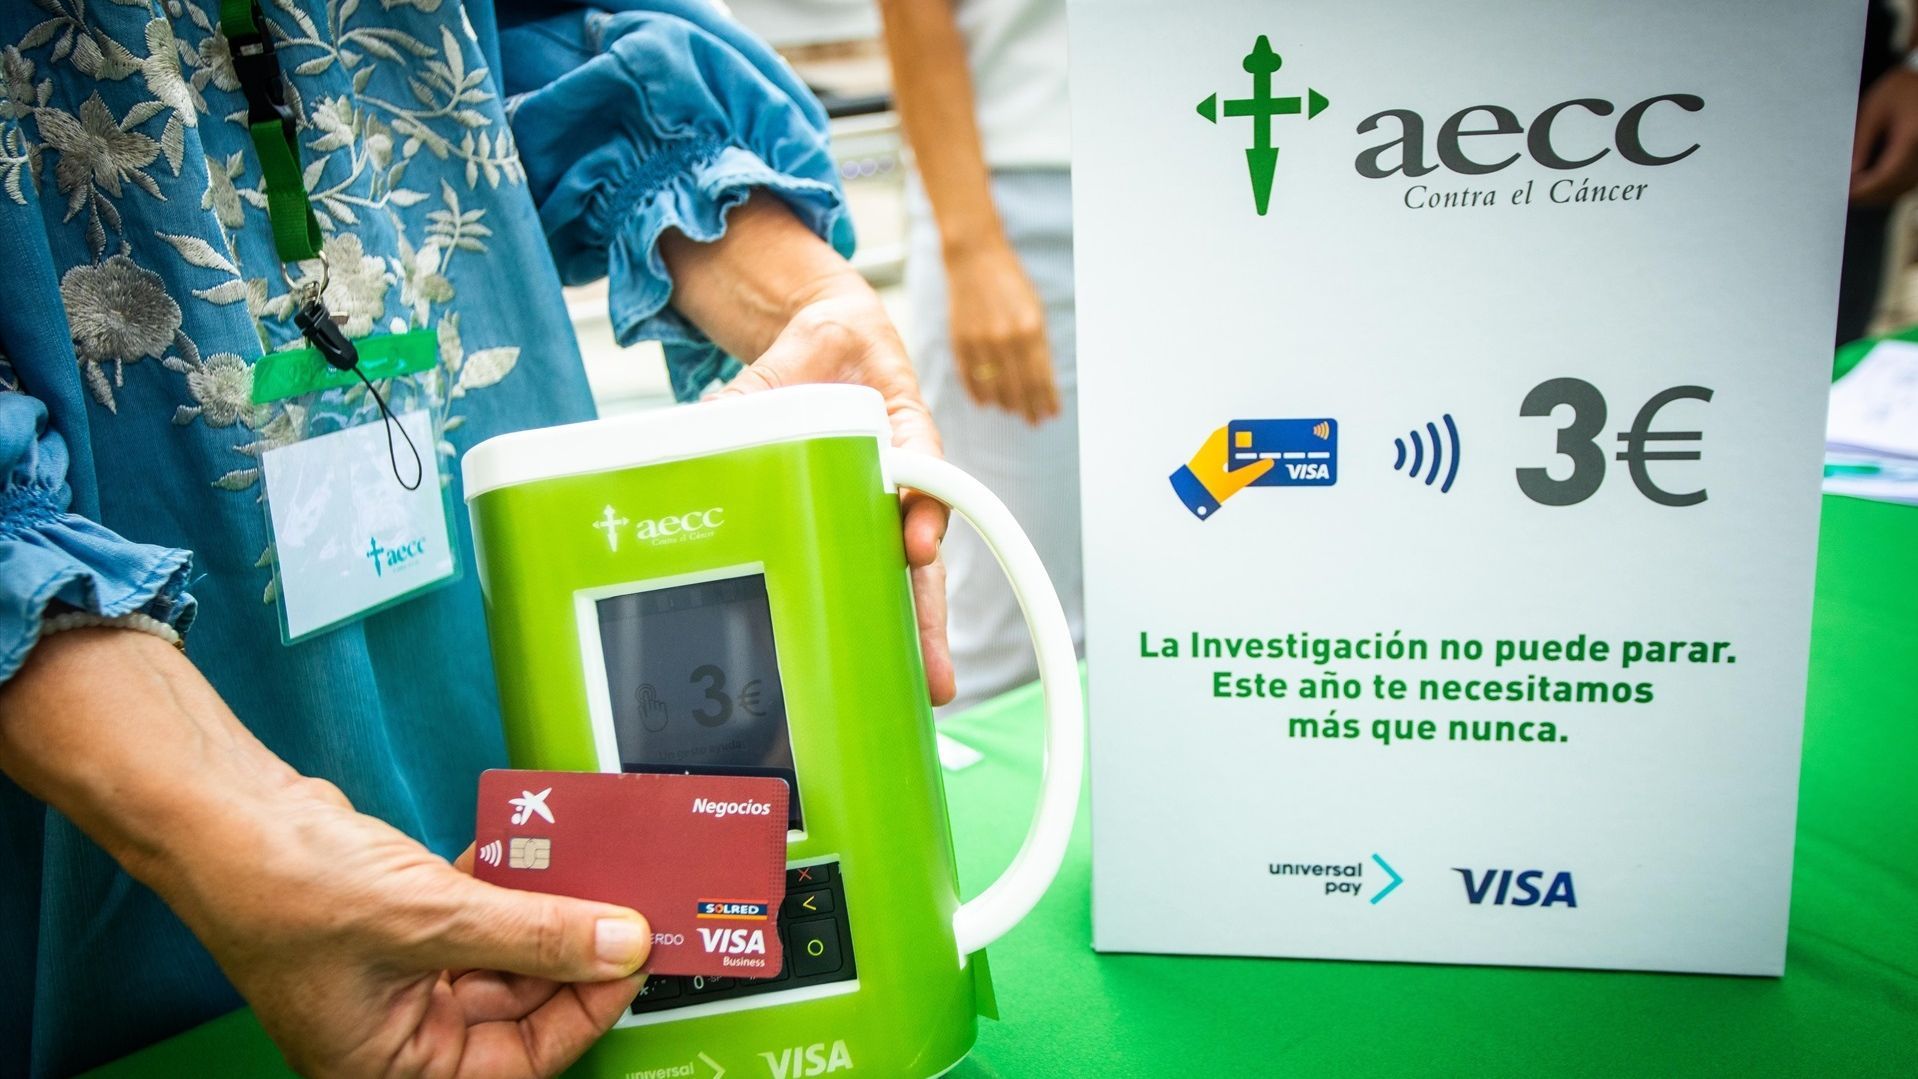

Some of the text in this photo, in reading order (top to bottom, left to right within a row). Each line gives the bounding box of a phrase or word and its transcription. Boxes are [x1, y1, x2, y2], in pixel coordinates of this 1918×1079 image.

[1355, 93, 1705, 179] aecc
[1404, 177, 1648, 210] Contra el Cáncer
[1515, 376, 1715, 508] 3€
[1285, 463, 1330, 481] VISA
[636, 506, 725, 539] aecc
[1140, 630, 1736, 669] La Investigación no puede parar.
[1212, 670, 1654, 704] Este año te necesitamos
[1288, 709, 1568, 746] más que nunca.
[692, 798, 772, 817] Negocios
[1268, 863, 1363, 877] universal
[1325, 880, 1362, 896] pay
[1450, 867, 1578, 908] VISA
[705, 903, 760, 915] SOLRED
[696, 927, 766, 954] VISA
[722, 956, 766, 968] Business
[757, 1039, 854, 1079] VISA
